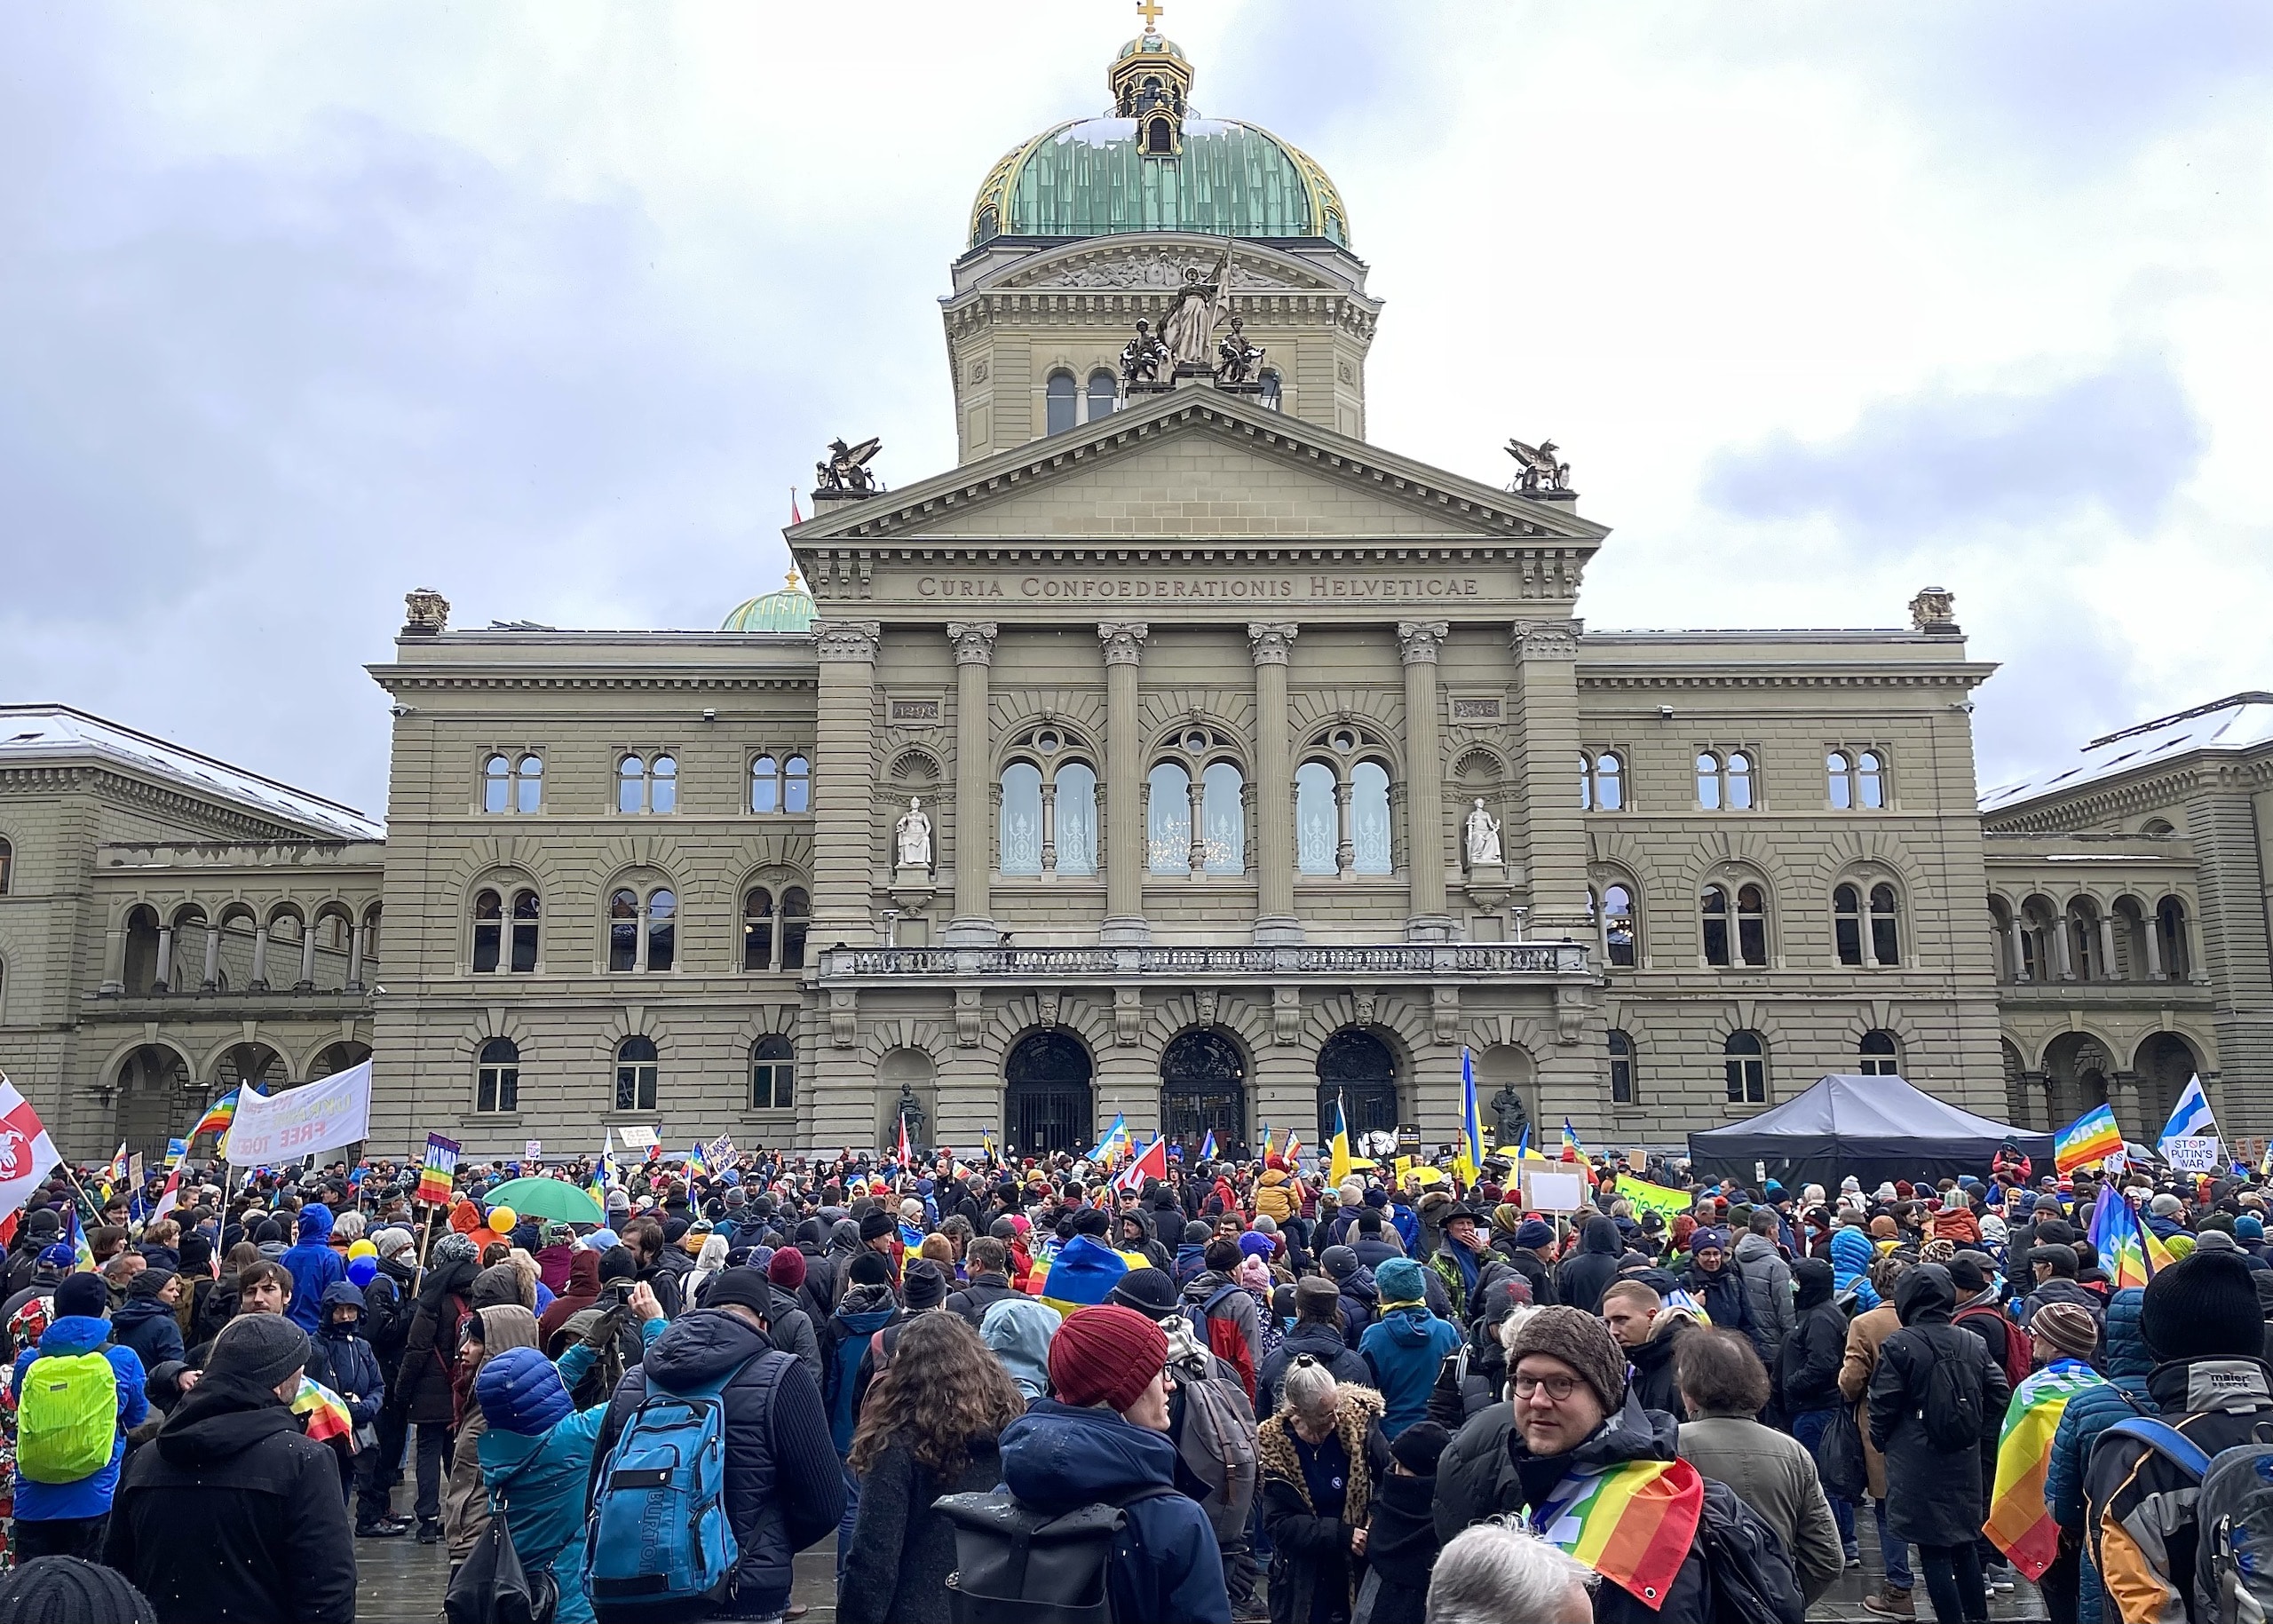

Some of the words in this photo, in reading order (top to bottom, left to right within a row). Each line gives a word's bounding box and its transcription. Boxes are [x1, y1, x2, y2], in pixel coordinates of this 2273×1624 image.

[916, 576, 1004, 597] CURIA
[1020, 576, 1292, 597] CONFOEDERATIONIS
[1310, 576, 1478, 596] HELVETICAE
[424, 1144, 439, 1169] NO
[2171, 1149, 2214, 1159] PUTIN'S
[2179, 1159, 2205, 1168] WAR
[2211, 1374, 2247, 1382] maier
